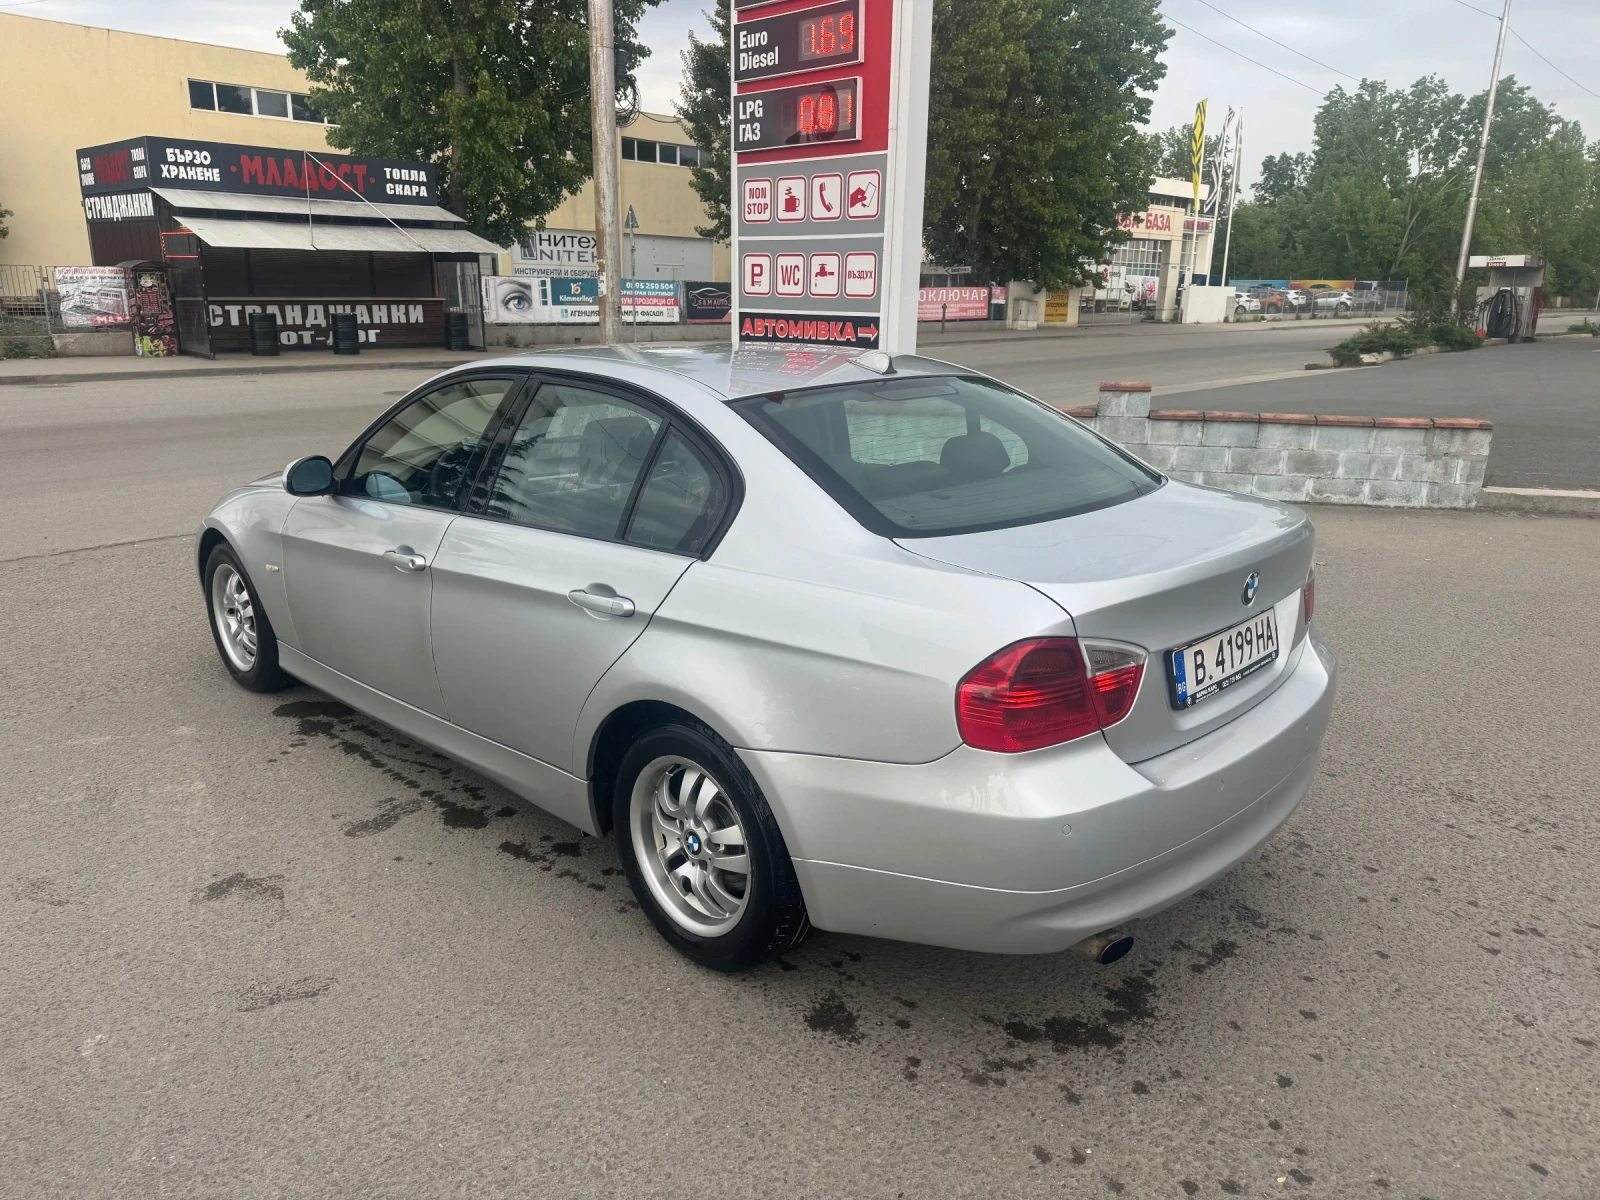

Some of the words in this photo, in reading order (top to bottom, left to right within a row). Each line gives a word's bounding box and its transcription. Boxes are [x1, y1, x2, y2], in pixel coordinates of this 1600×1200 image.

[740, 30, 768, 50] Euro
[811, 14, 854, 53] 1.69
[740, 46, 779, 71] Diesel
[739, 99, 763, 119] LPG
[799, 94, 853, 132] 0.81
[739, 122, 761, 143] ГАЗ
[165, 147, 212, 165] БЪРЗО
[160, 164, 221, 182] ХРАНЕНЕ
[240, 154, 367, 193] МЛАДОСТ
[384, 167, 428, 182] ТОПЛА
[386, 183, 428, 197] СКАРА
[749, 187, 767, 199] NON
[85, 192, 155, 222] СТРАНДЖАНКИ
[746, 203, 769, 215] STOP
[1145, 213, 1171, 232] БАЗА
[514, 267, 562, 277] ИНСТРУМЕНТИ
[780, 264, 800, 286] WC
[847, 270, 873, 281] ВЪЗДУХ
[646, 282, 659, 290] 250
[667, 299, 674, 307] ОТ
[741, 318, 856, 341] АВТОМИВКА
[1178, 682, 1186, 694] BG
